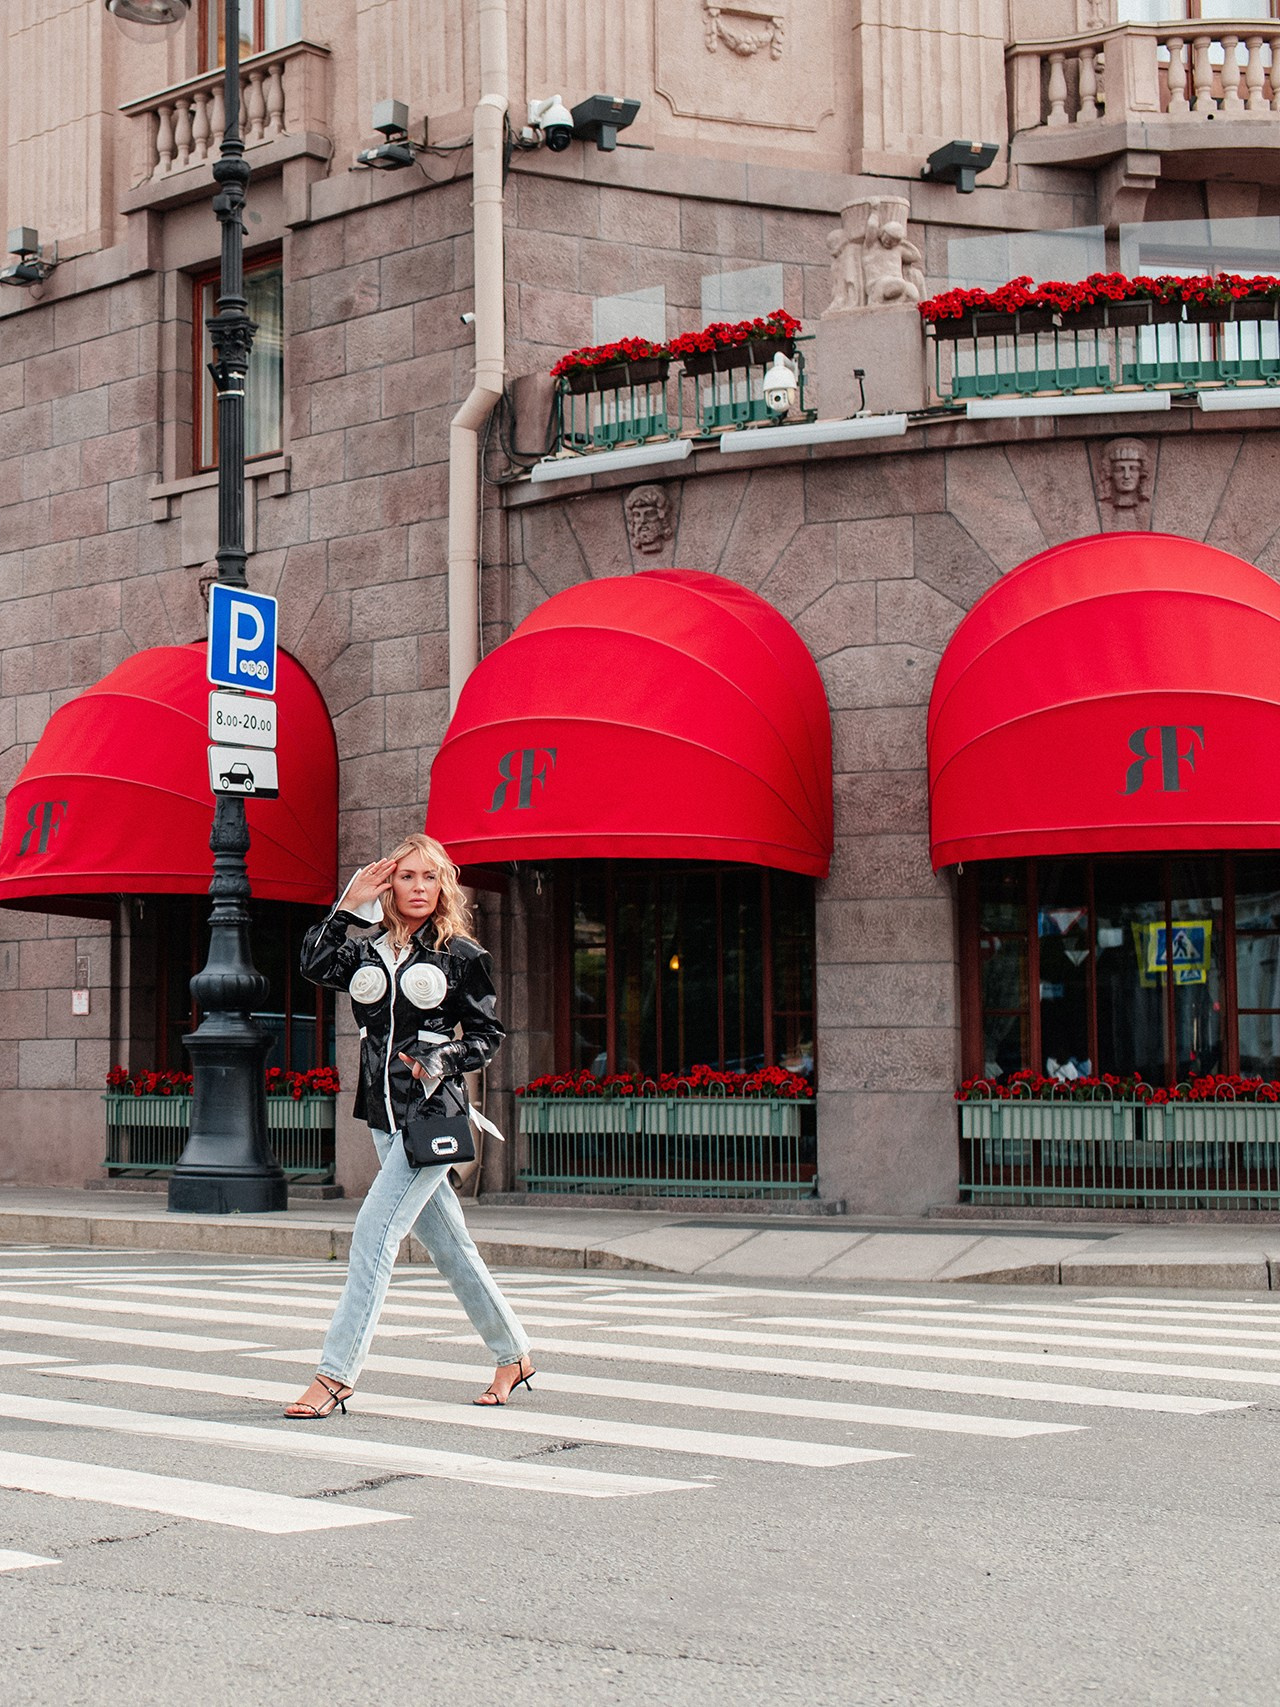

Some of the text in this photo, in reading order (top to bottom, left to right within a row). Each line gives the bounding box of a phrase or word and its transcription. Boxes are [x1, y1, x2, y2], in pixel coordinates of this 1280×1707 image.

[228, 599, 265, 675] P
[257, 664, 268, 676] 20
[215, 709, 272, 733] 8.00-20.00
